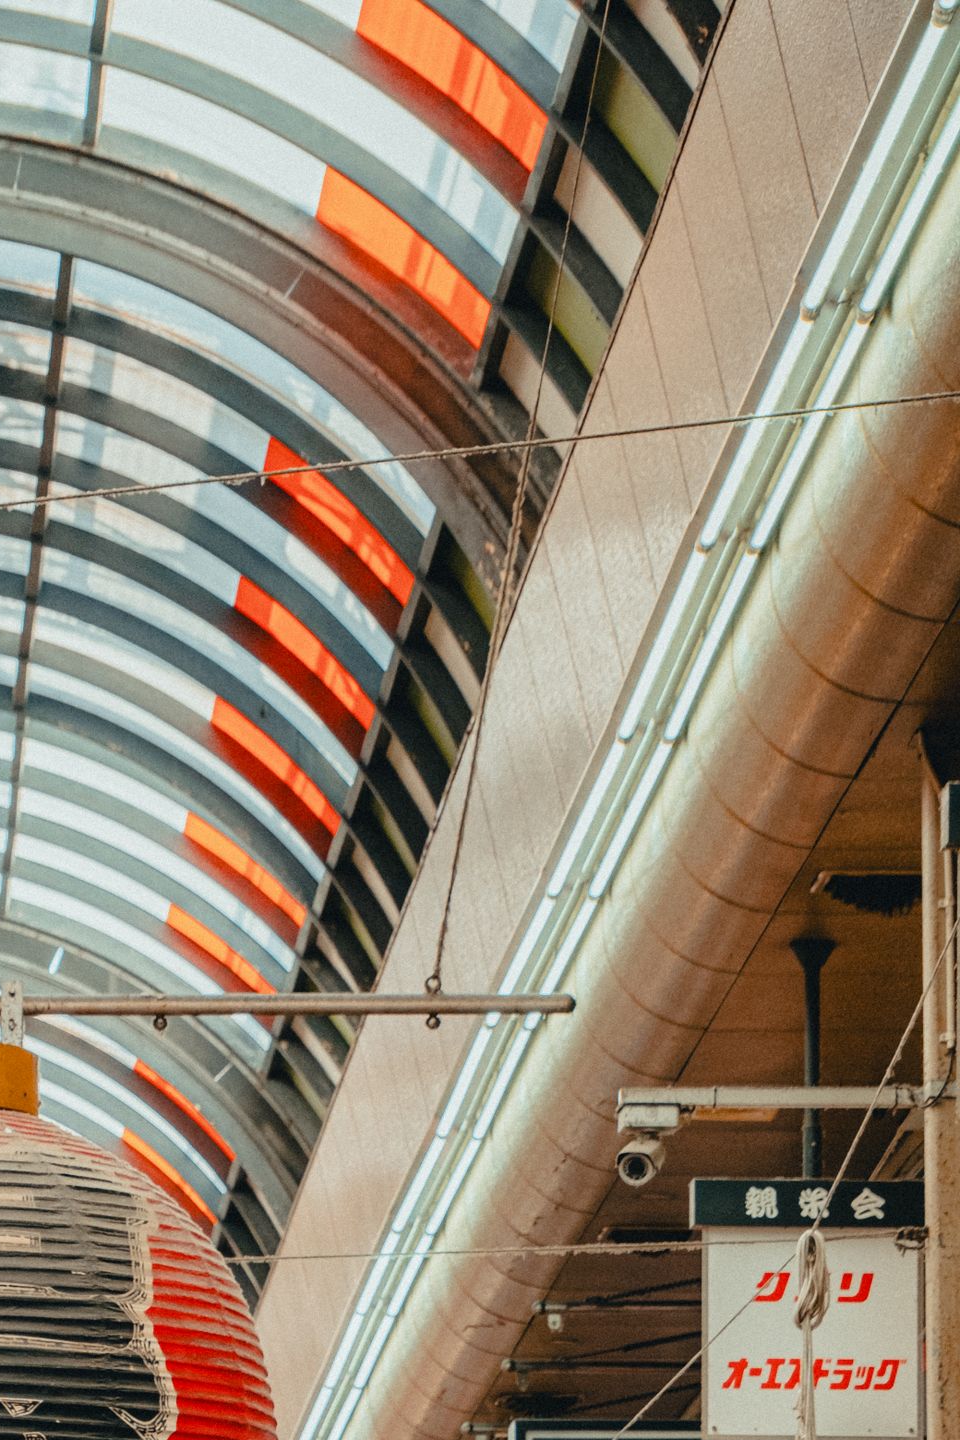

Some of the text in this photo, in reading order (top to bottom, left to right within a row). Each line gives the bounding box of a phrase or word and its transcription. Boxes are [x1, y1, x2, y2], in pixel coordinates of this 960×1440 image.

[745, 1186, 886, 1220] 親栄会
[753, 1272, 874, 1303] クリ
